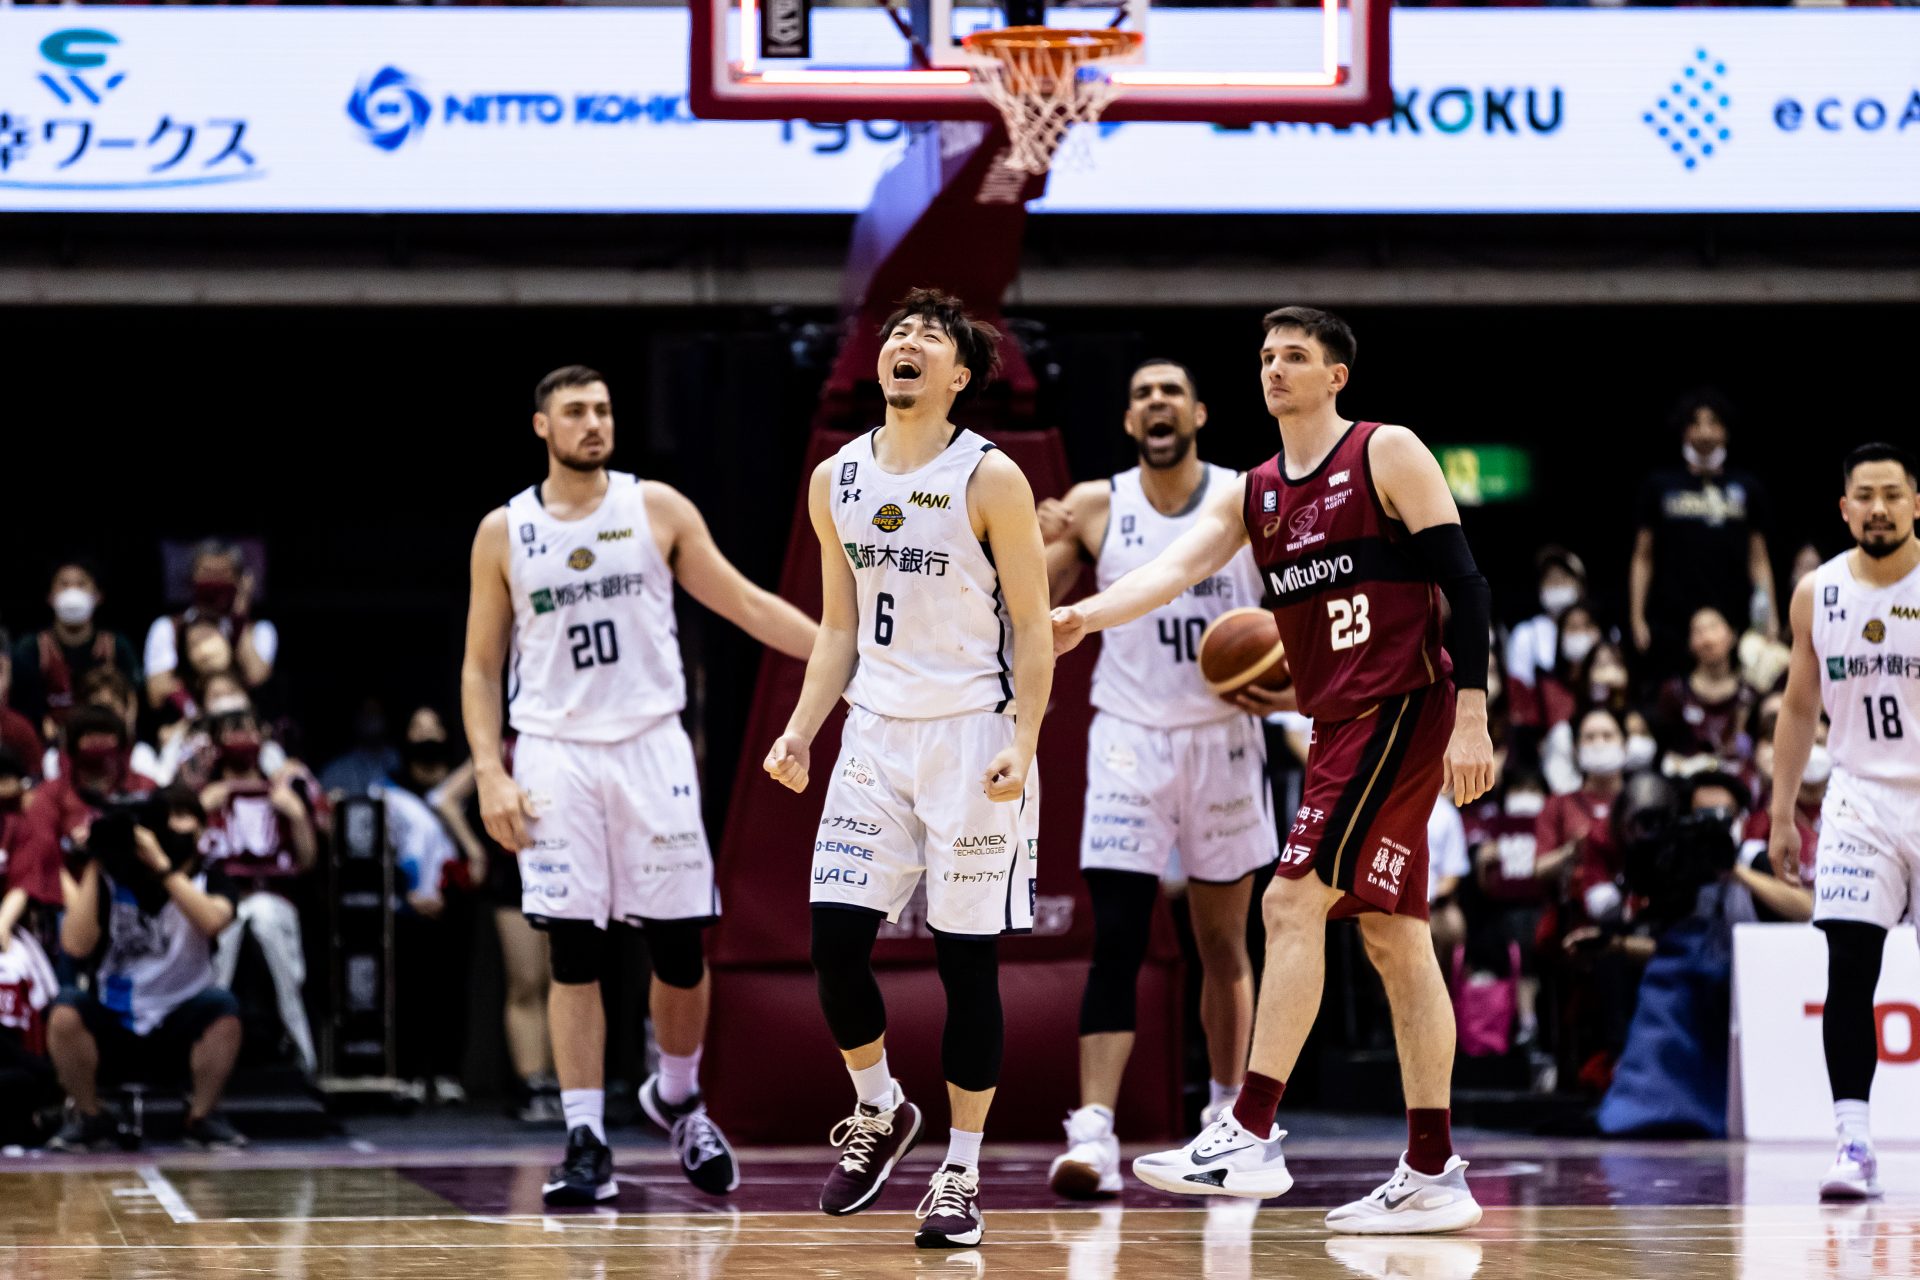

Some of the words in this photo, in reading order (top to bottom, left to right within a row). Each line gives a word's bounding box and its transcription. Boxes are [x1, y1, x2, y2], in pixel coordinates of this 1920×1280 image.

[445, 94, 563, 122] NITTO
[1325, 489, 1352, 504] RECRUIT
[872, 516, 905, 526] BREX
[858, 544, 950, 576] 栃木銀行
[1270, 555, 1353, 596] Mitubyo
[874, 591, 895, 646] 6
[1327, 593, 1371, 651] 23
[568, 619, 619, 670] 20
[1158, 616, 1207, 663] 40
[1863, 695, 1903, 741] 18
[953, 834, 1007, 847] ALMEX
[953, 846, 1005, 857] TECHNOLOGIES
[814, 867, 868, 886] UACJ
[1367, 872, 1377, 884] En
[1803, 1002, 1920, 1067] O
